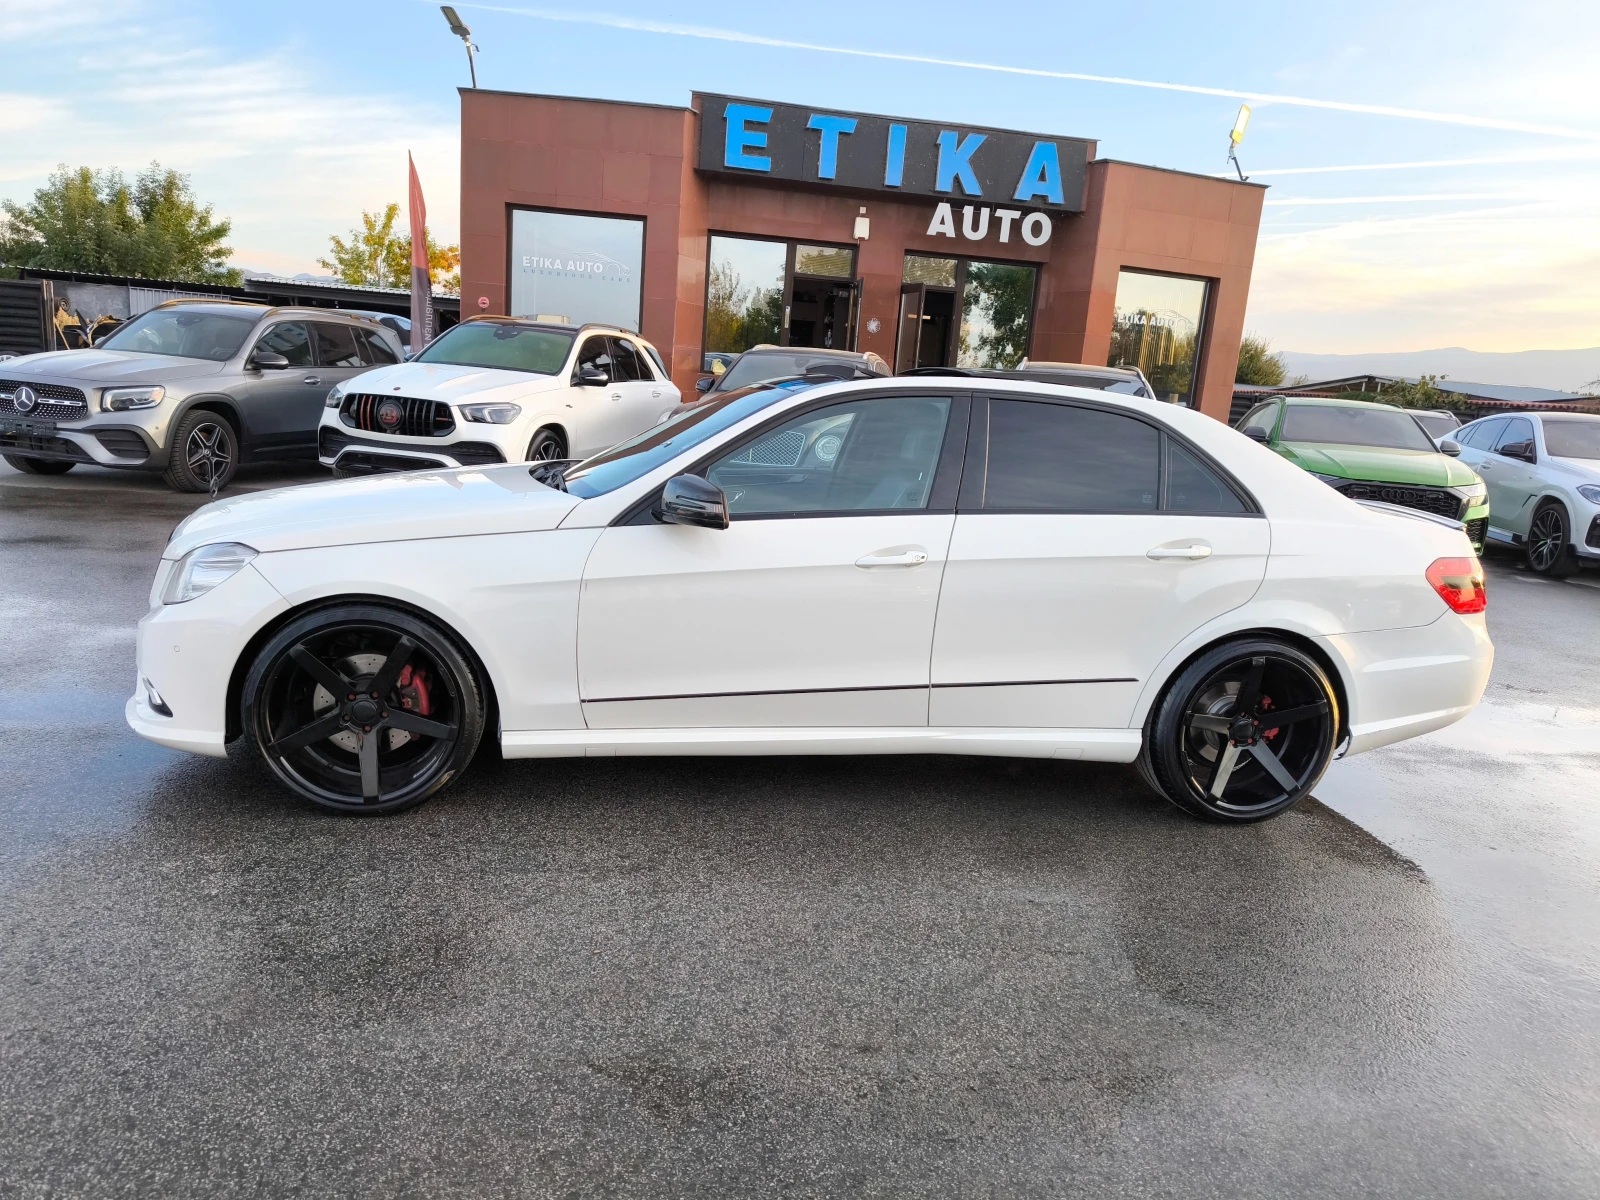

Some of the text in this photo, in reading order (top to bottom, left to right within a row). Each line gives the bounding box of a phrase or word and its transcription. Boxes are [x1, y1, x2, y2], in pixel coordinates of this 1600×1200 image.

[724, 103, 1064, 204] ETIKA
[926, 203, 1052, 246] AUTO
[522, 256, 603, 273] ETIKA AUTO
[1117, 313, 1147, 325] ETIKA
